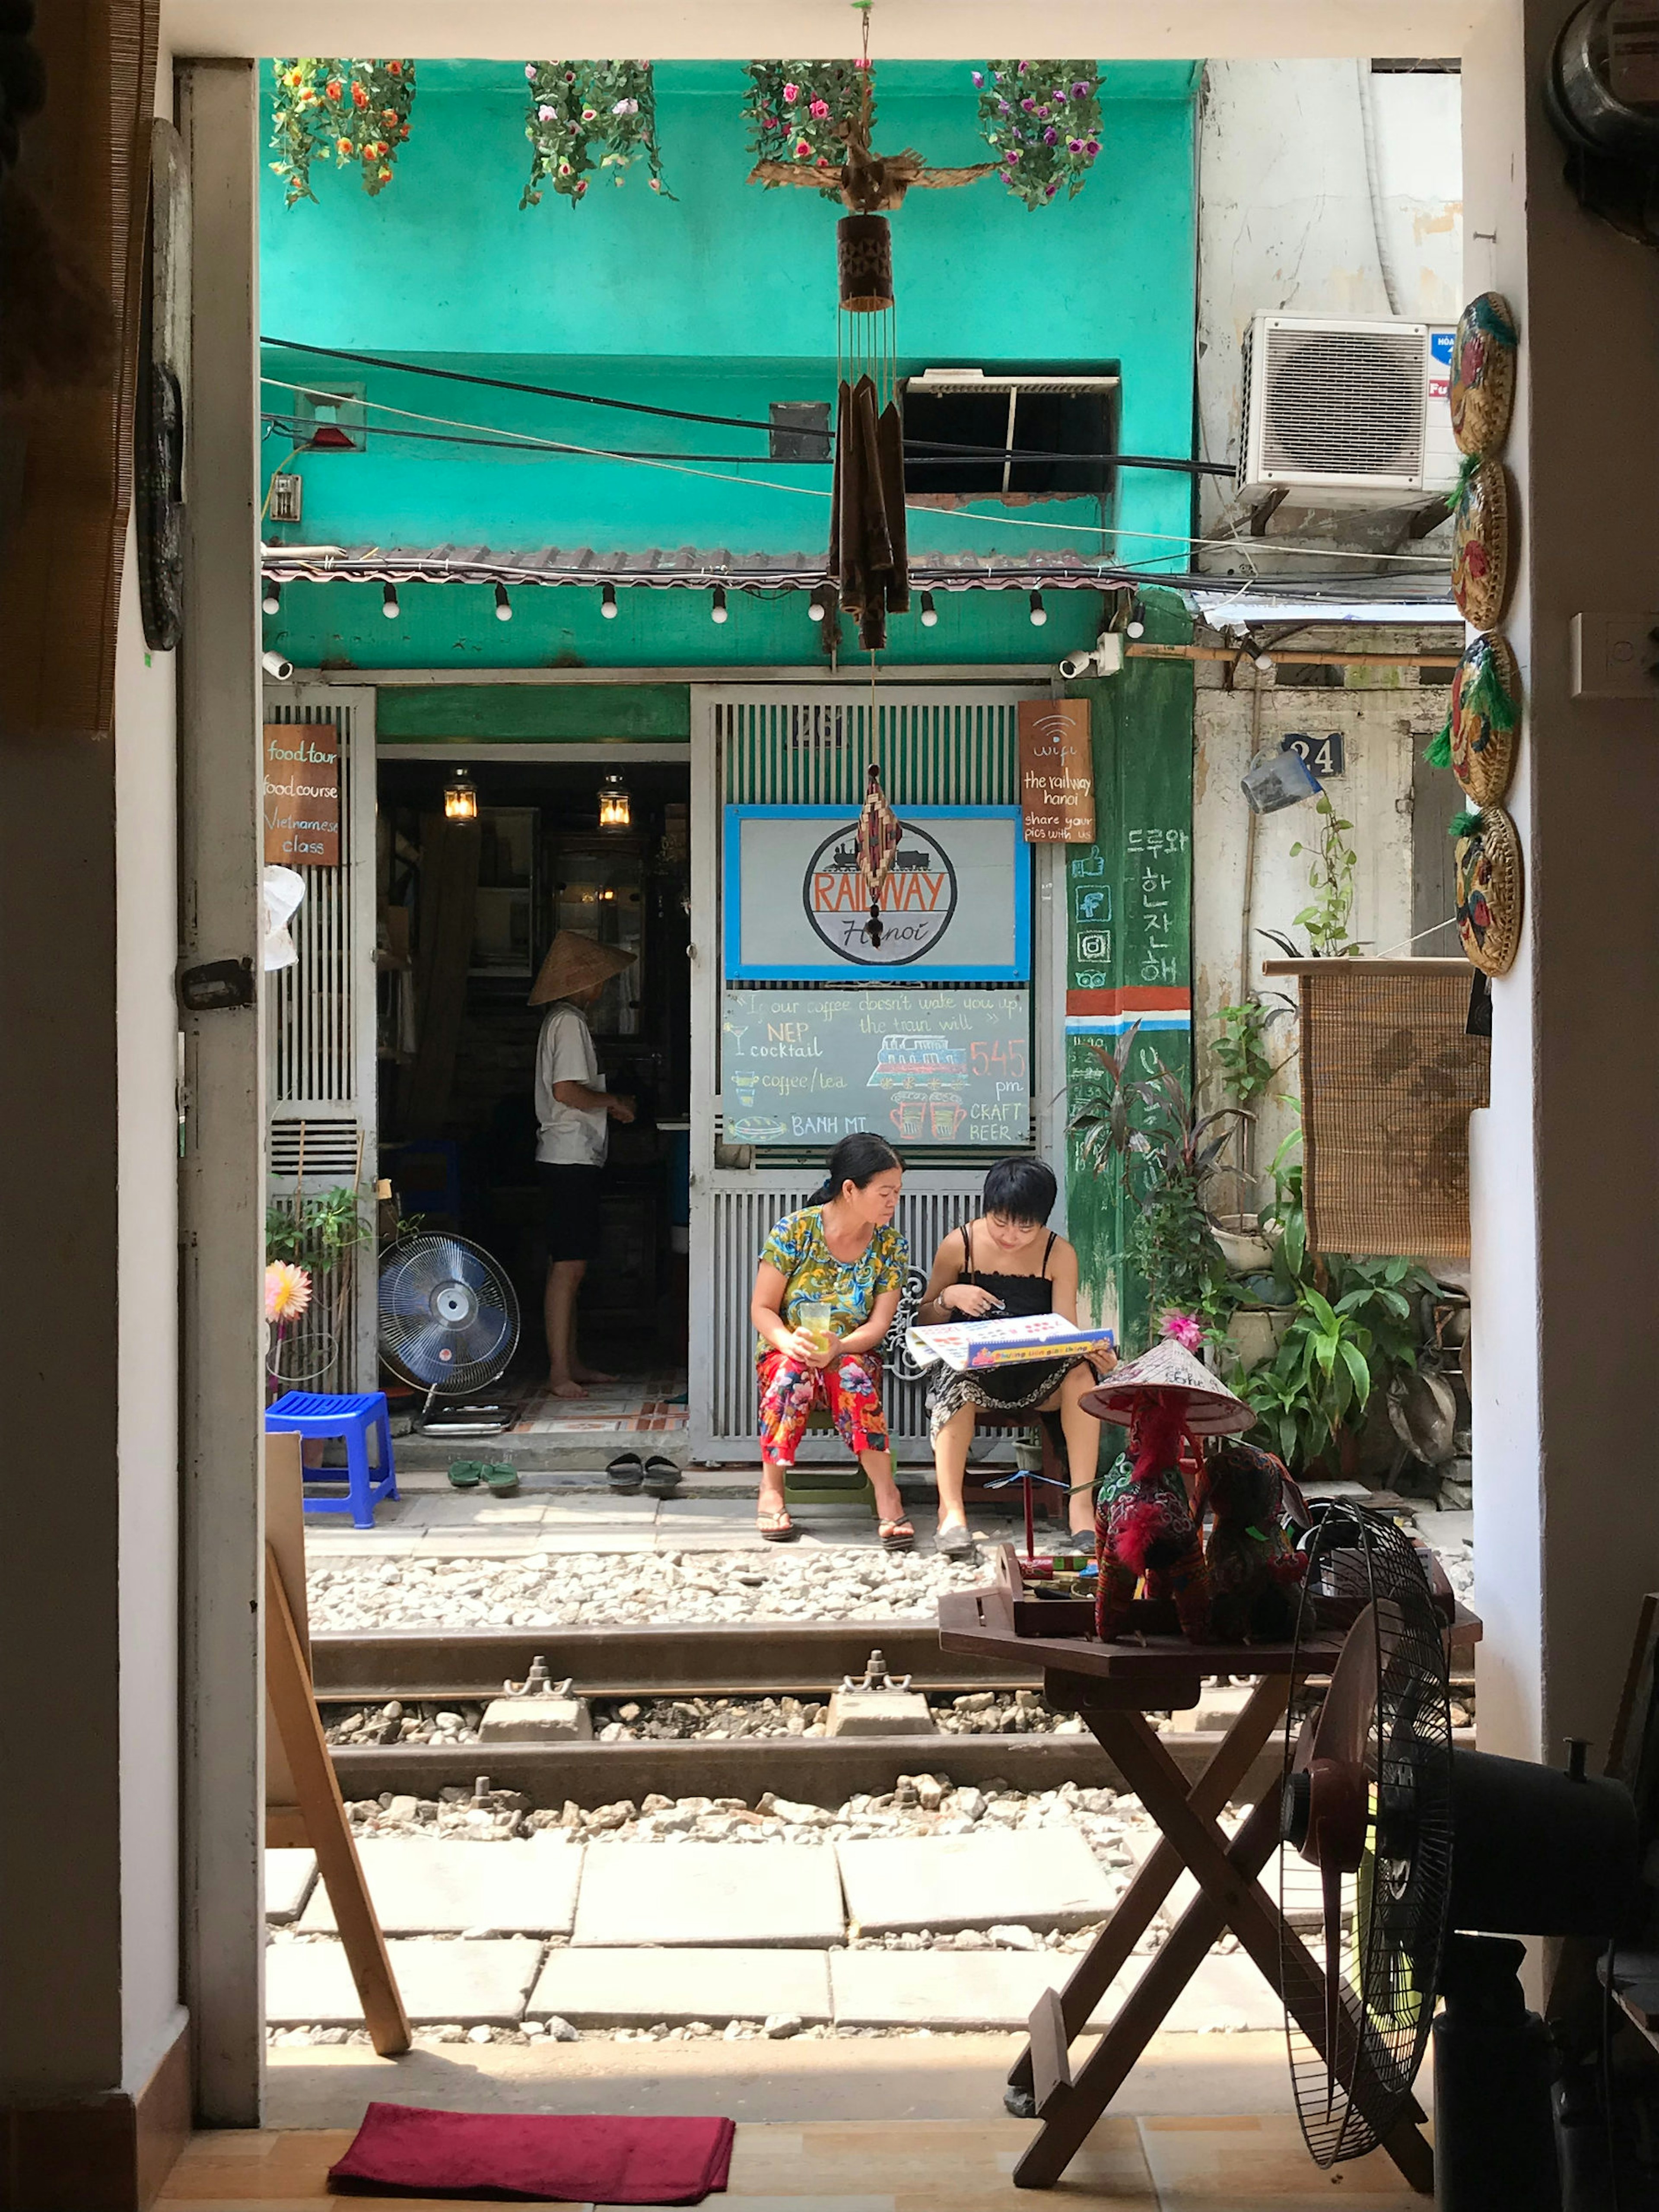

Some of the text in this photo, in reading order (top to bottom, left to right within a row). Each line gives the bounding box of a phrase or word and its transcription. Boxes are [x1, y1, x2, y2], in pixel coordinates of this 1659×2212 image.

[267, 739, 337, 764] food tour
[1033, 746, 1077, 766] wifi
[264, 774, 338, 798] food course
[1024, 767, 1091, 797] the railway
[1044, 789, 1078, 805] hanoi
[264, 806, 338, 834] Vietnamese
[1025, 811, 1093, 830] share your
[282, 834, 324, 855] class
[1024, 827, 1091, 842] pics with us
[1127, 828, 1189, 859] 드루와
[814, 873, 945, 911] RAILWAY
[841, 920, 930, 946] Hnoi
[1140, 866, 1177, 983] 한잔해
[771, 1002, 800, 1014] our
[807, 1000, 851, 1022] coffee
[859, 992, 912, 1011] doesn't
[918, 994, 957, 1010] wake
[963, 997, 994, 1011] you
[767, 1022, 809, 1043] NEP
[859, 1013, 973, 1034] the train will
[750, 1036, 823, 1058] cocktail
[762, 1067, 848, 1096] coffee/tea
[995, 1081, 1024, 1101] pm
[970, 1103, 1023, 1121] CRAFT
[791, 1115, 837, 1137] BANH
[970, 1124, 1011, 1141] BEER
